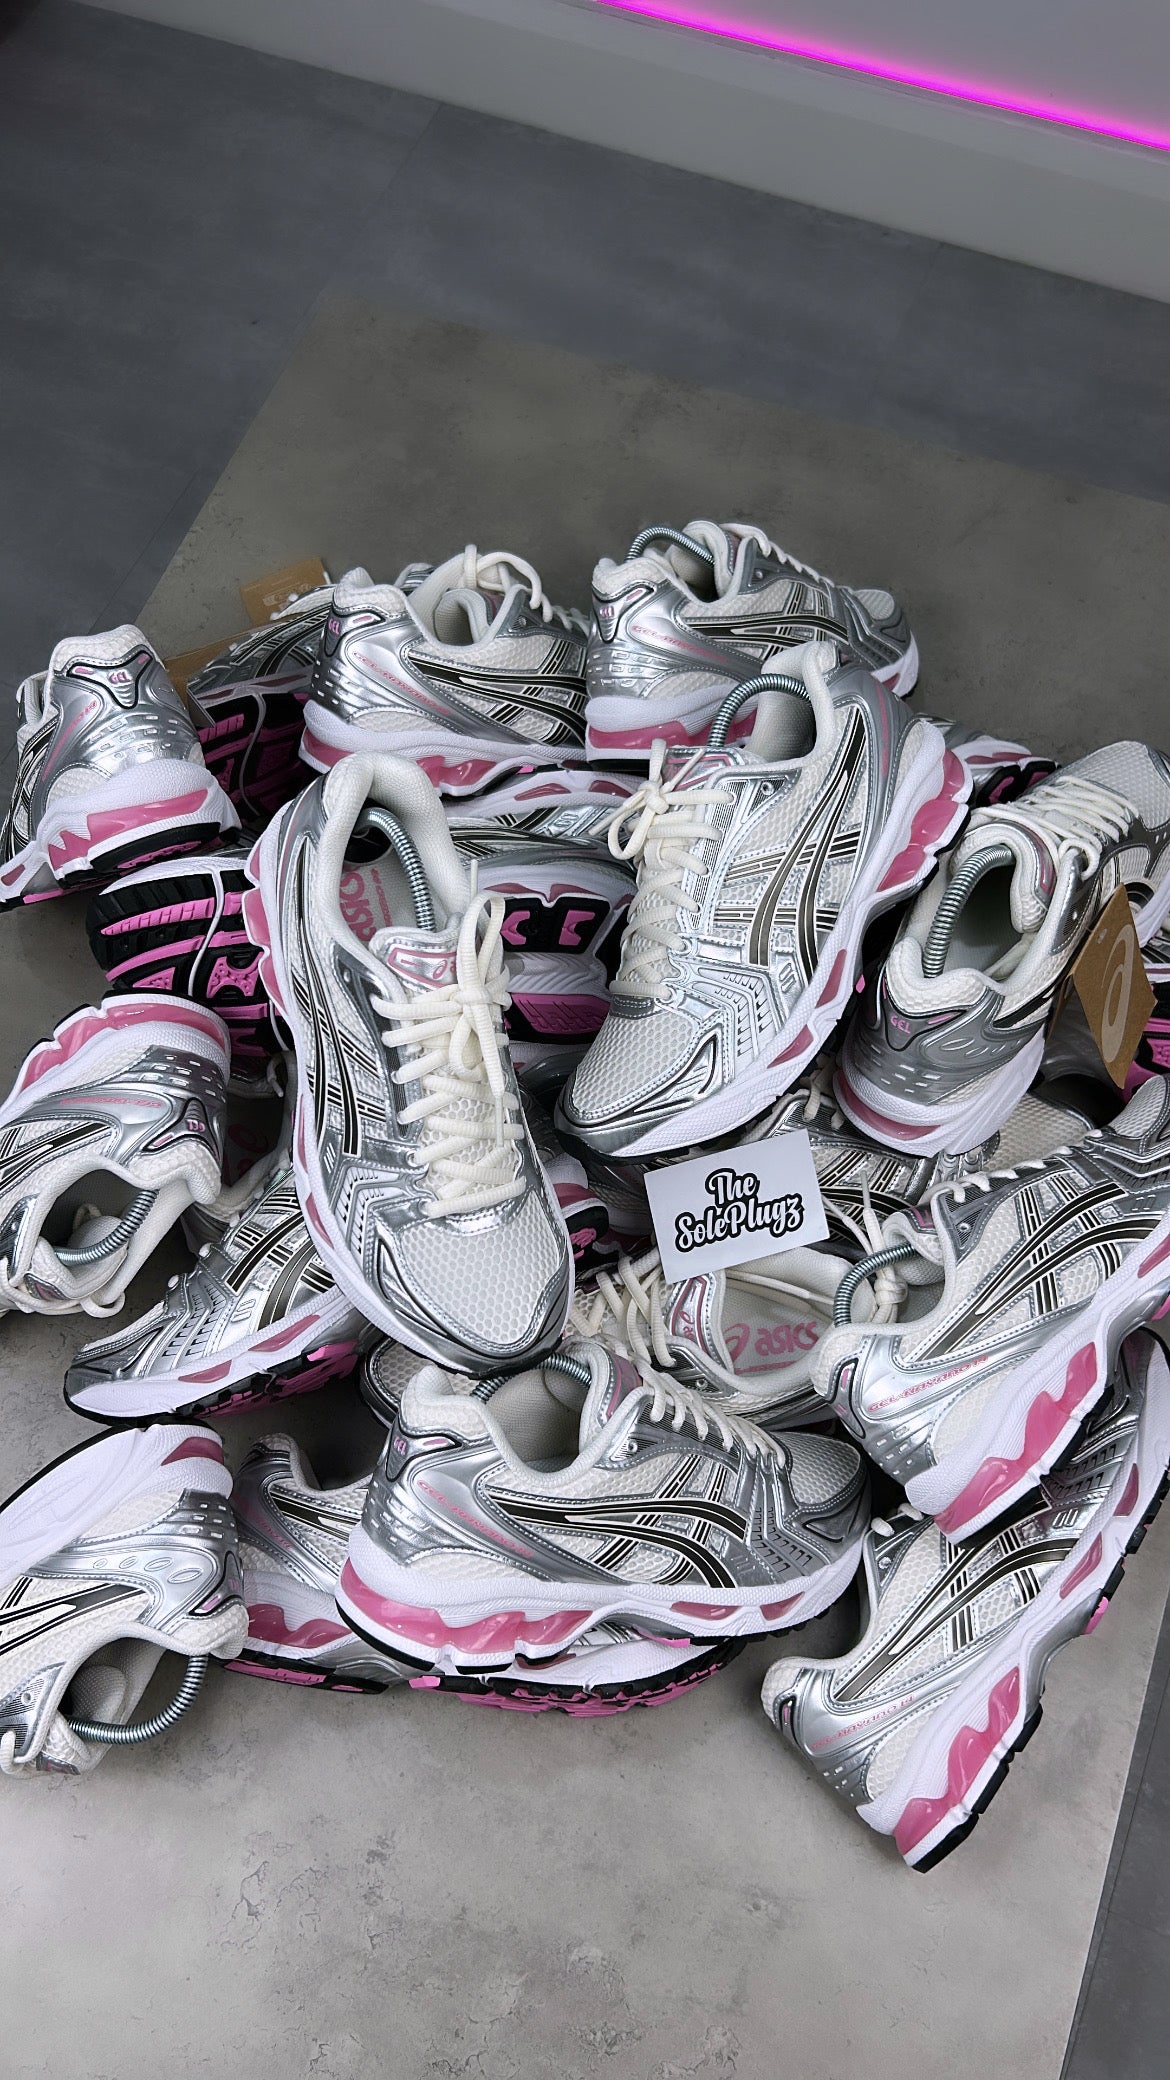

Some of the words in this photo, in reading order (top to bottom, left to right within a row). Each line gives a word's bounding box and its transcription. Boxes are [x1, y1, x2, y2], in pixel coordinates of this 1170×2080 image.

[108, 670, 131, 684] GEL
[339, 864, 377, 941] asic
[890, 1014, 911, 1035] GEL
[186, 1119, 206, 1133] GEL
[704, 1167, 760, 1208] The
[675, 1193, 805, 1252] SolePlugz
